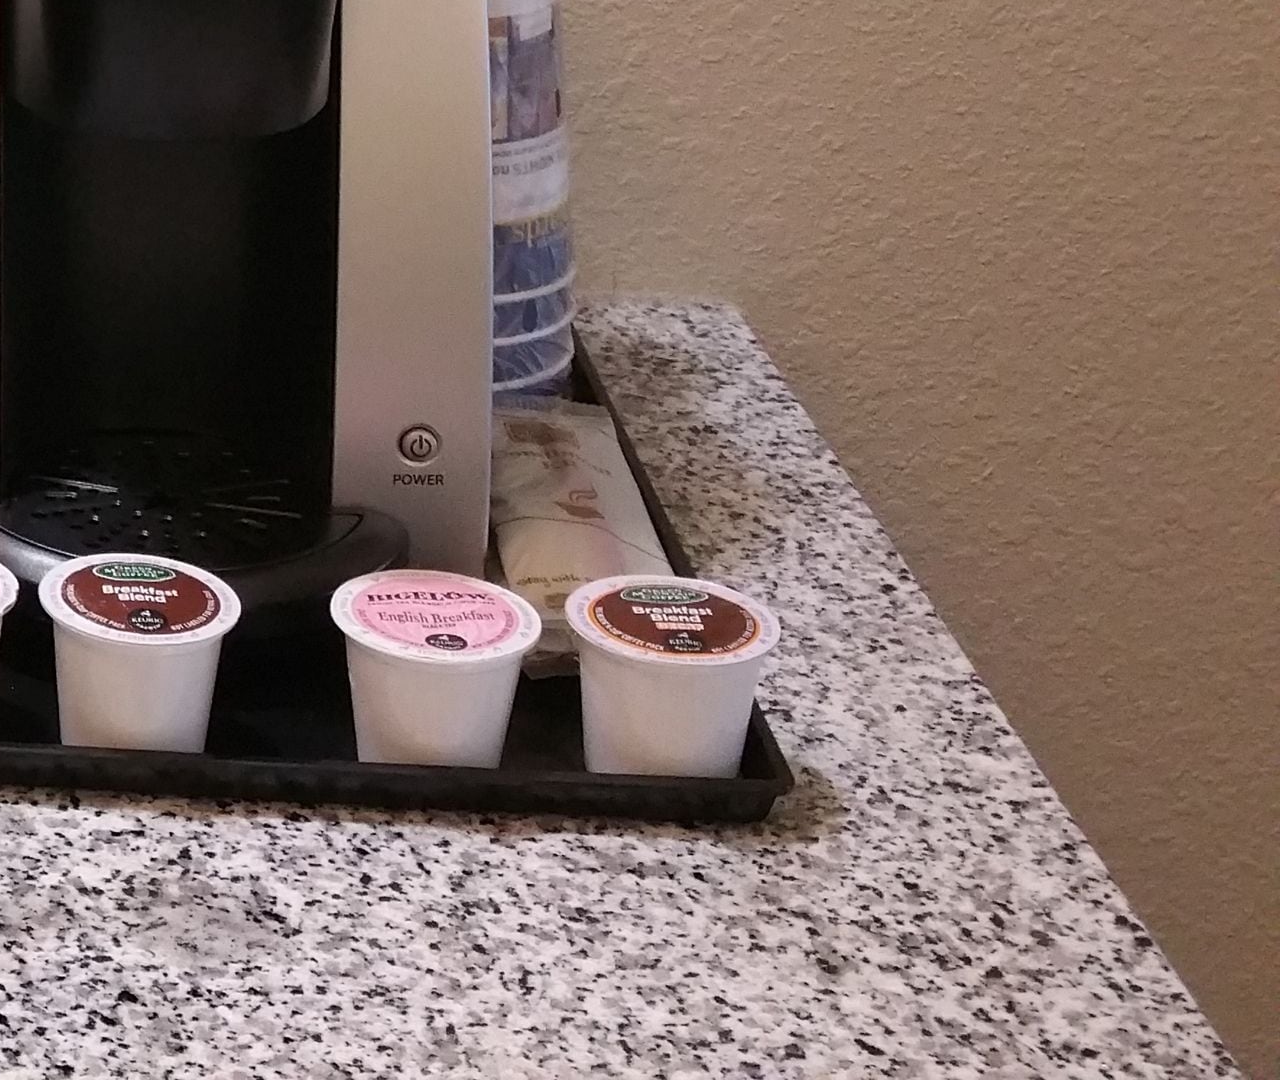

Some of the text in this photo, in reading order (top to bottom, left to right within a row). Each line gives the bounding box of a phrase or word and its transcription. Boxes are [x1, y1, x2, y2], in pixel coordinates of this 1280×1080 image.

[392, 473, 444, 486] POWER
[101, 584, 179, 597] Breakfast
[118, 592, 167, 604] Blend
[377, 610, 429, 625] English
[430, 609, 496, 624] Breakfast
[631, 606, 713, 617] Breakfast
[650, 613, 702, 623] Blend
